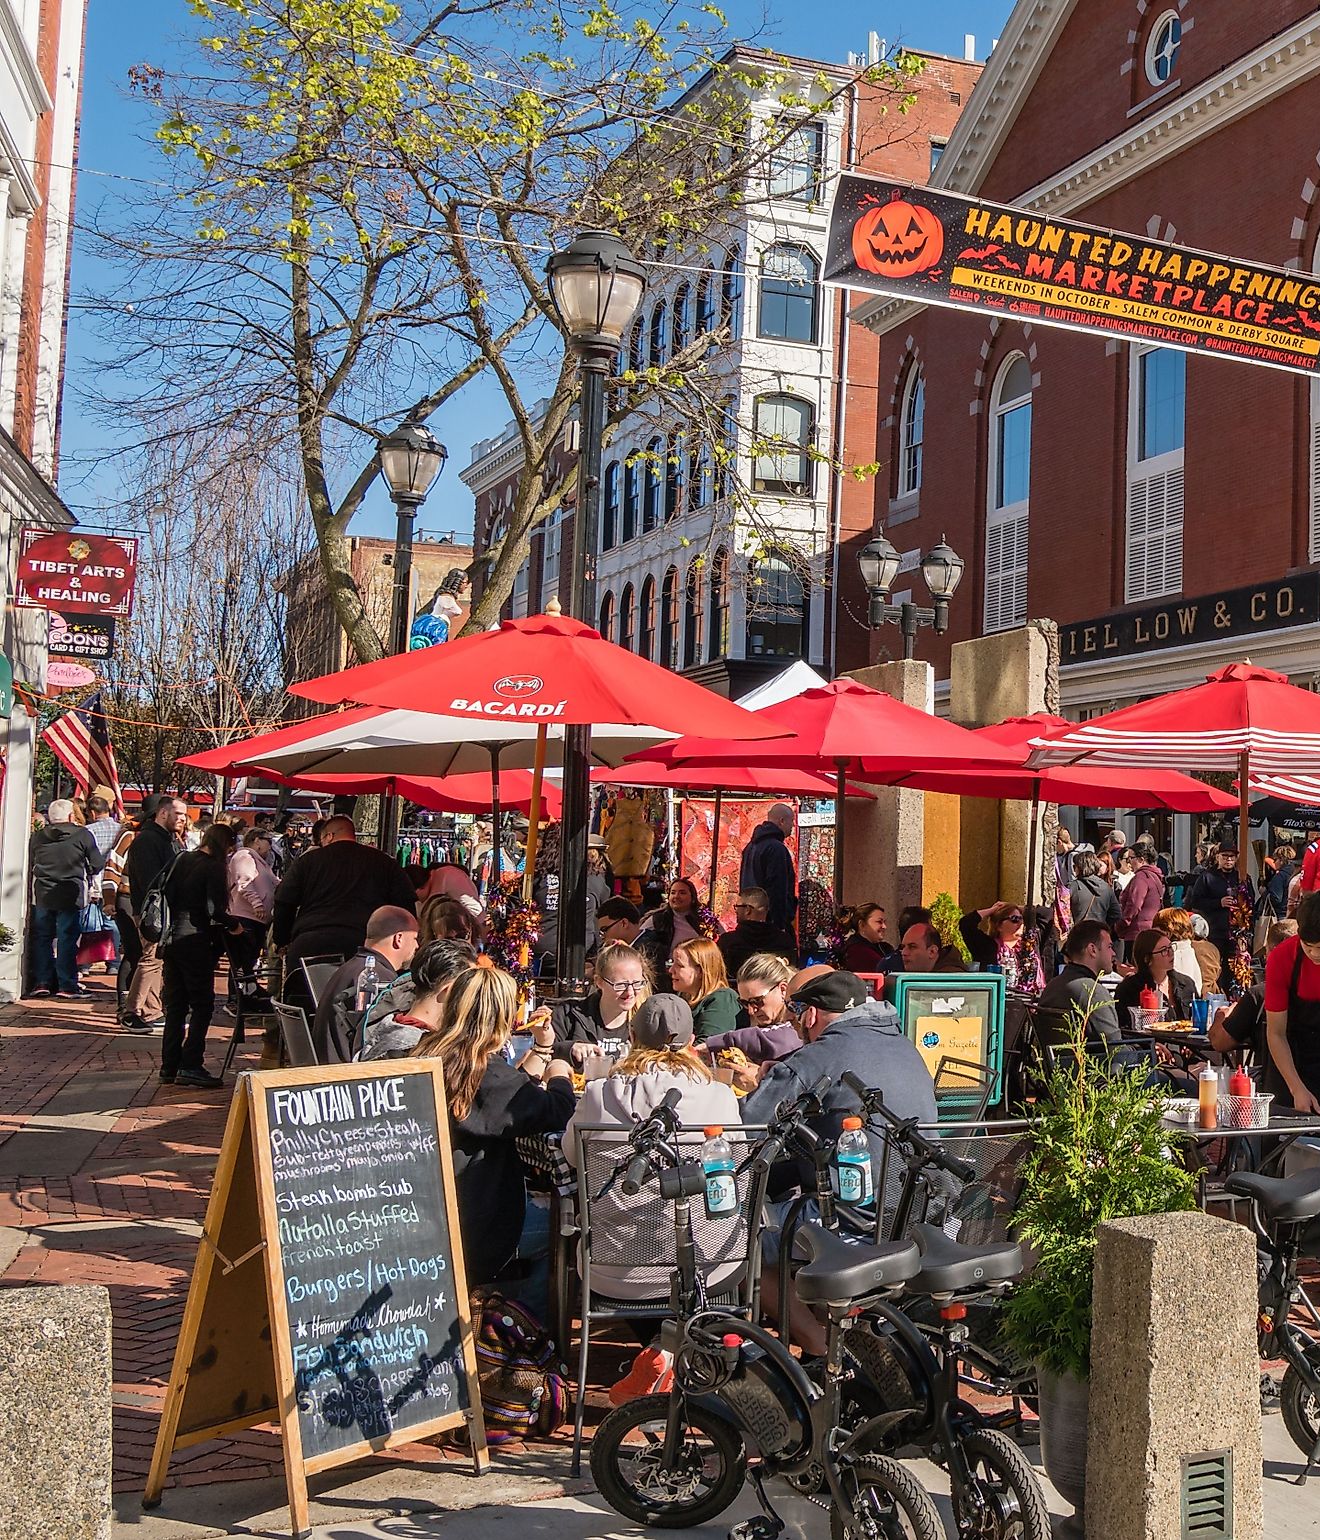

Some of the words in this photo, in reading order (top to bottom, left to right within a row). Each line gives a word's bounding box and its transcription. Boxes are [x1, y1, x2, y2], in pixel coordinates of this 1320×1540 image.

[964, 207, 1133, 266] HAUNTED
[949, 288, 974, 299] SALEM
[1024, 252, 1275, 325] MARKETPLACE
[972, 273, 1036, 295] WEEKENDS
[1040, 286, 1053, 299] IN
[1056, 290, 1110, 310] OCTOBER
[1122, 303, 1160, 319] SALEM
[1162, 311, 1213, 329] COMMON
[1216, 323, 1225, 332] &
[1228, 323, 1264, 340] DERBY
[1264, 332, 1305, 349] SQUARE
[1044, 306, 1198, 345] HAUNTEDHAPPENINGSMARKETPLACE.COM
[1205, 337, 1317, 369] @HAUNTEDHAPPENINGSMARKET
[29, 559, 78, 574] TIBET
[81, 565, 126, 579] ARTS
[69, 577, 82, 588] &
[37, 588, 111, 604] HEALING
[1135, 605, 1198, 643] LOW
[1213, 600, 1232, 628] &
[1251, 586, 1305, 622] CO.
[50, 643, 68, 651] CARD
[75, 645, 90, 654] GIFT
[91, 647, 108, 656] SHOP
[273, 1085, 355, 1126] FOUNTAIN
[358, 1077, 407, 1118] PLACE
[275, 1188, 333, 1213] Steak
[335, 1182, 377, 1202] bomb
[380, 1177, 413, 1197] Sub
[708, 1187, 728, 1201] ERO
[336, 1234, 384, 1257] toast
[409, 1253, 447, 1281] Dogs
[310, 1310, 374, 1338] Homemade
[375, 1295, 436, 1327] Chowdah
[333, 1323, 430, 1361] Sandwich
